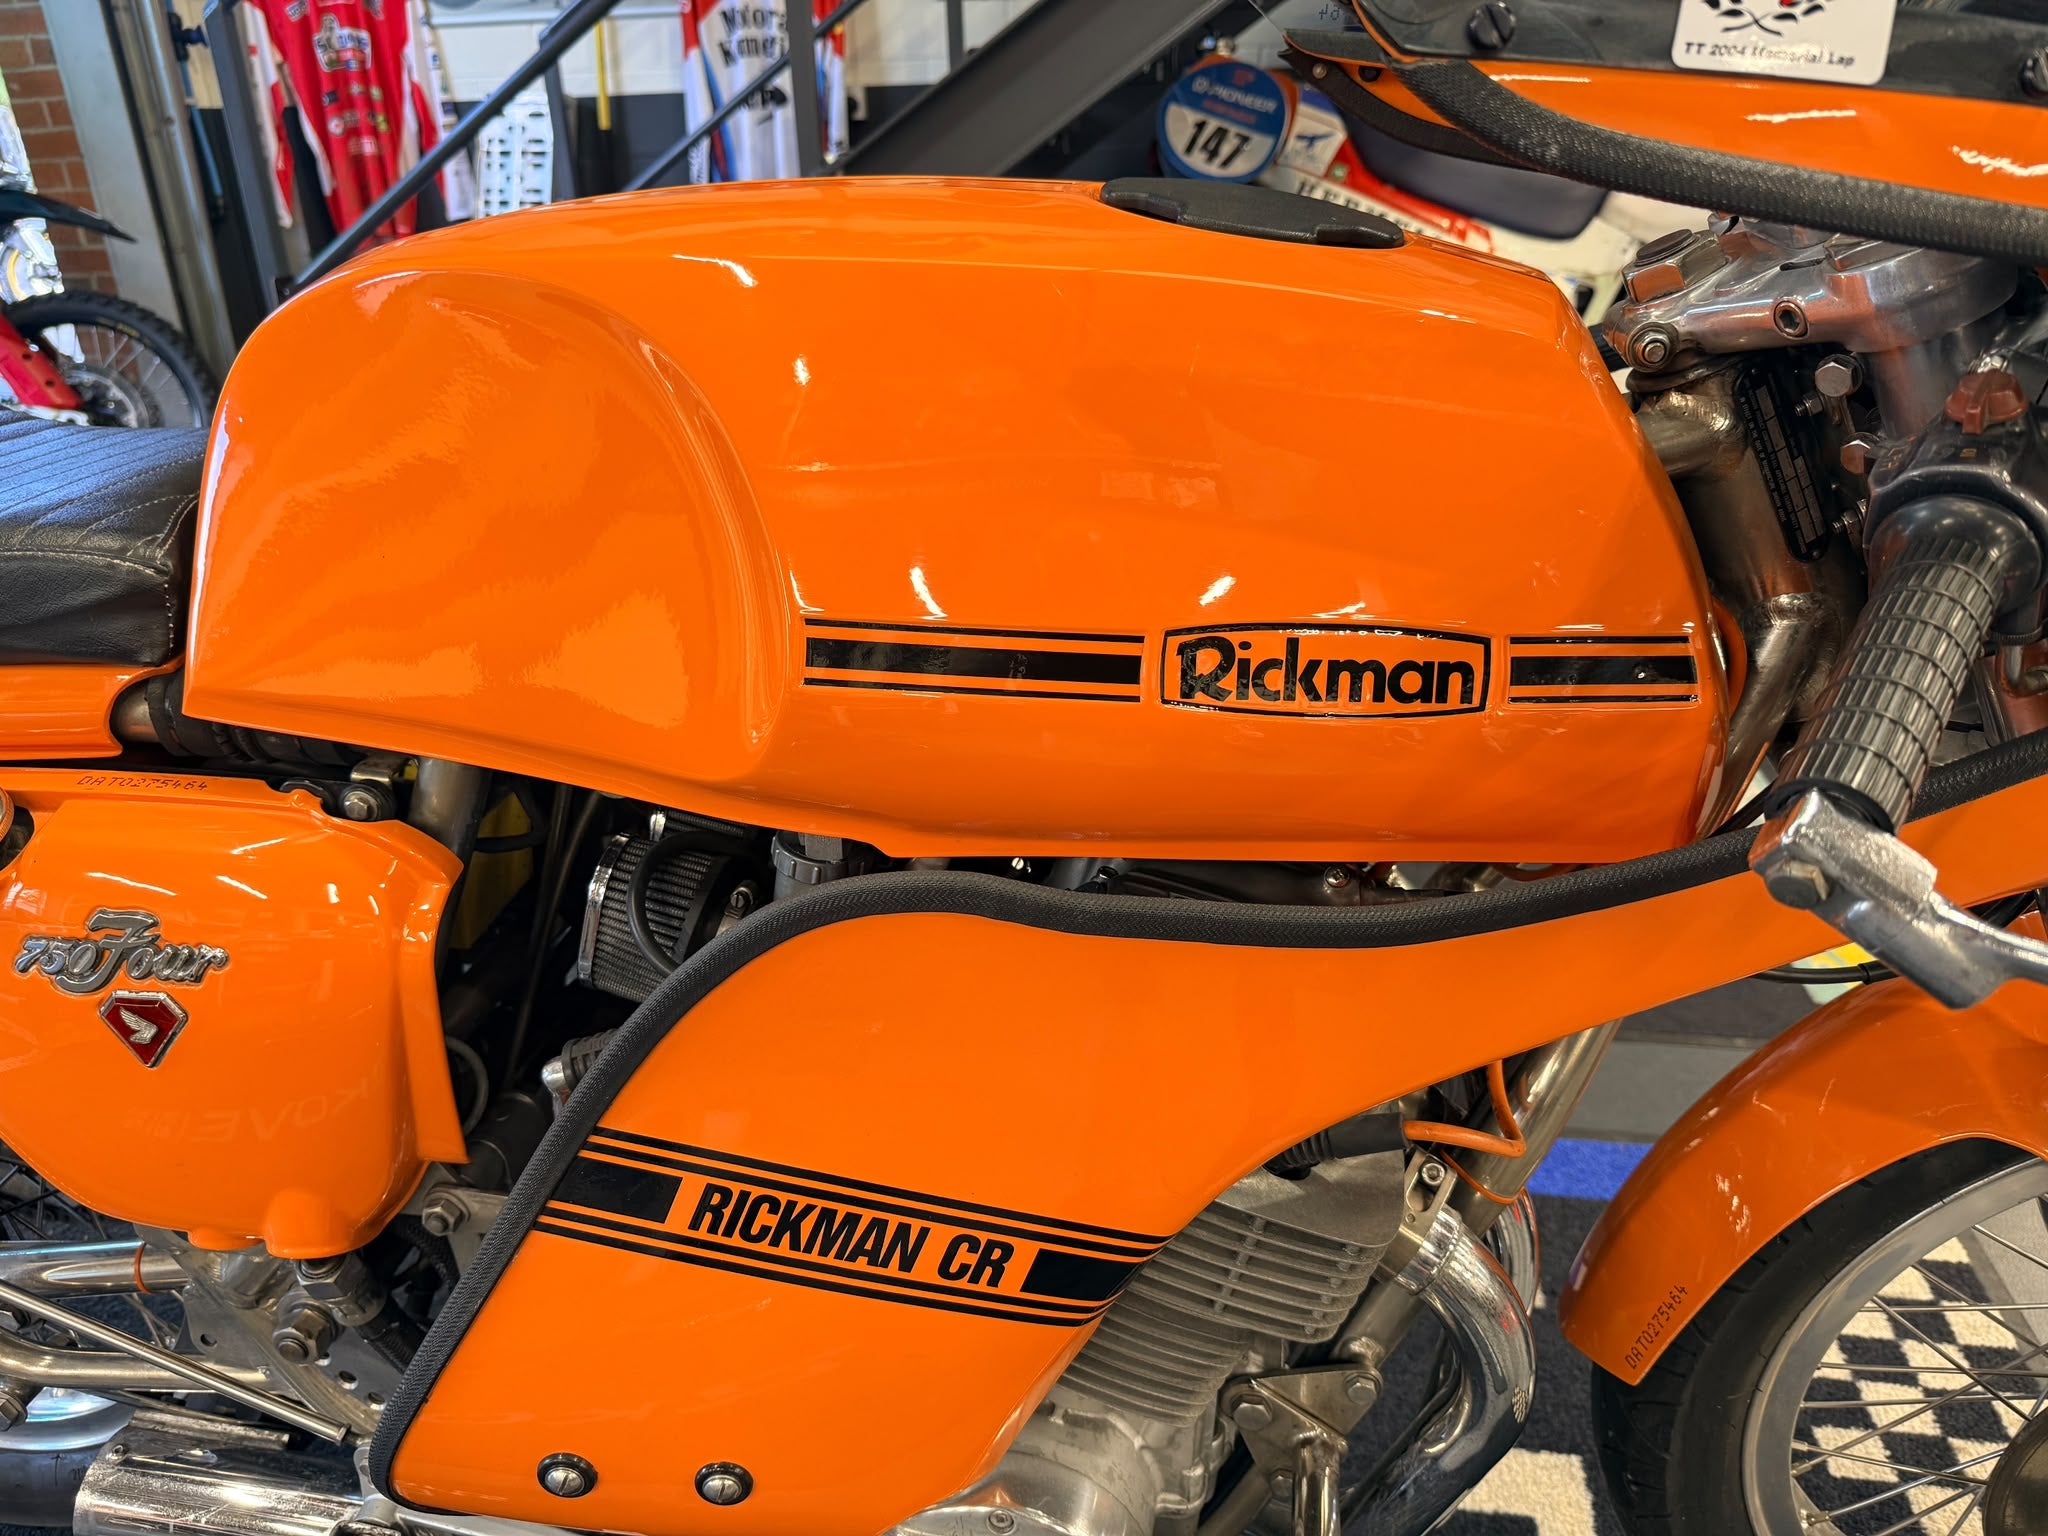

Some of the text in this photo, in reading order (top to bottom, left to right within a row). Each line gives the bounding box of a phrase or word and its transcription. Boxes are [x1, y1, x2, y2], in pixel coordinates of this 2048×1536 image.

[1685, 42, 1706, 54] TT
[1828, 53, 1854, 67] Lap
[1184, 119, 1250, 169] 147
[1177, 636, 1475, 704] Rickman
[688, 1182, 1015, 1288] RICKMAN CR
